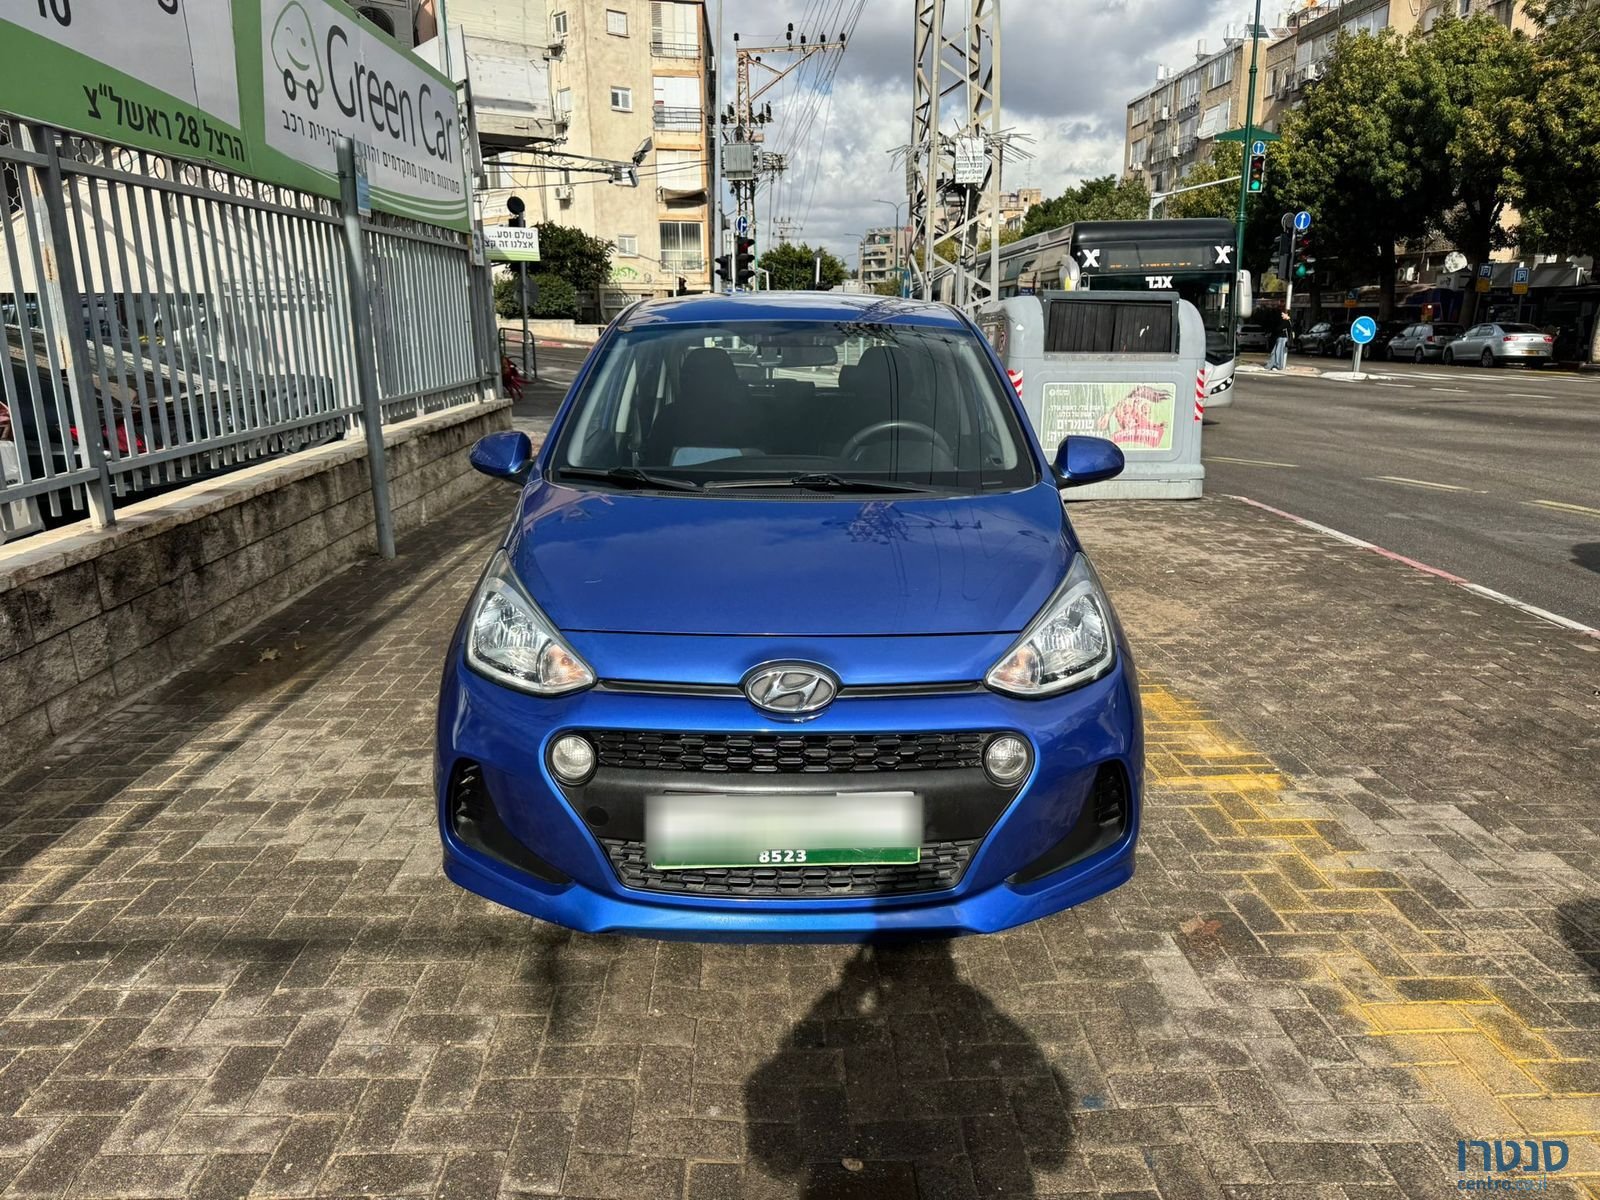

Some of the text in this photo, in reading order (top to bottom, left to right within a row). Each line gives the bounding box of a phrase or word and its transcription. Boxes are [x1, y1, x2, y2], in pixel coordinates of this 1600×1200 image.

[327, 24, 453, 164] Green Car
[175, 111, 200, 149] 28
[281, 109, 305, 137] רכב
[203, 118, 245, 162] הרצל
[382, 151, 418, 179] מתקדמים
[484, 240, 534, 249] אצלנו זה קצ
[515, 231, 533, 239] שלם
[1057, 419, 1094, 430] שומרים
[759, 849, 807, 863] 8523
